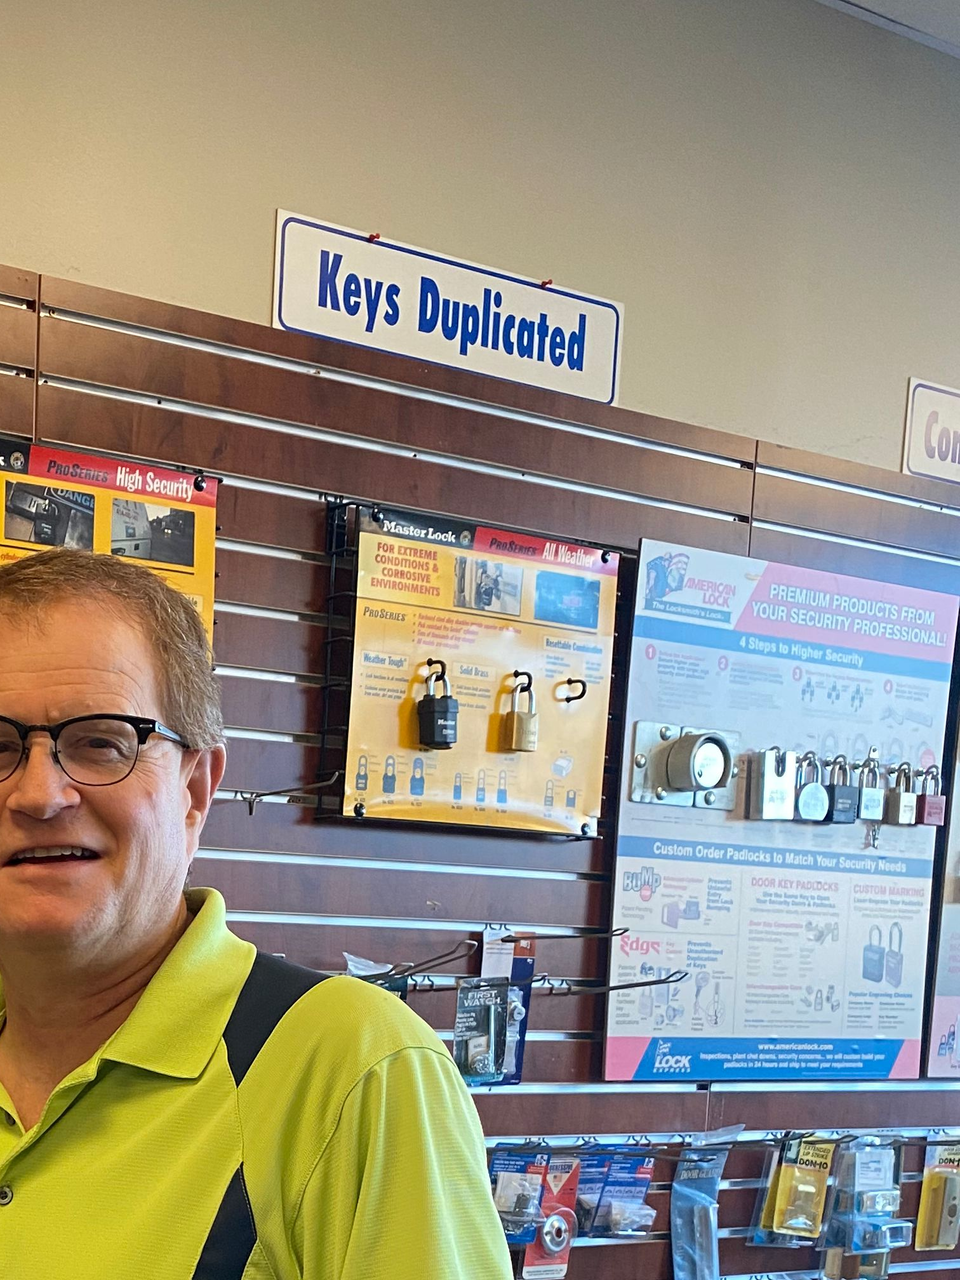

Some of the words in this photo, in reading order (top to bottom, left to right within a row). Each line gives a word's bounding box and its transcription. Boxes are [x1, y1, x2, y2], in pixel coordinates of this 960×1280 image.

[318, 250, 400, 332] Keys
[418, 276, 586, 371] Duplicated
[117, 466, 142, 492] High
[146, 472, 193, 502] Security
[383, 520, 426, 538] Master
[428, 527, 456, 543] Lock
[377, 541, 395, 554] FOR
[397, 545, 437, 560] EXTREME
[543, 542, 555, 560] All
[559, 545, 594, 567] Weather
[375, 554, 429, 572] CONDITIONS
[432, 564, 439, 572] &
[381, 566, 431, 583] CORROSIVE
[371, 577, 440, 597] ENVIRONMENTS
[685, 577, 736, 597] AMERICAN
[652, 601, 665, 611] The
[702, 591, 730, 609] LOCK
[770, 584, 830, 607] PREMIUM
[833, 595, 898, 619] PRODUCTS
[901, 607, 935, 625] FROM
[752, 601, 787, 621] YOUR
[790, 609, 851, 632] SECURITY
[854, 619, 947, 647] PROFESSIONAL!
[740, 637, 746, 648] 4
[748, 638, 777, 655] Steps
[779, 641, 789, 654] to
[792, 643, 823, 663] Higher
[826, 649, 864, 667] Security
[653, 842, 693, 857] Custom
[696, 845, 724, 859] Order
[727, 847, 771, 863] Padlocks
[773, 852, 782, 864] to
[785, 852, 813, 867] Match
[816, 855, 837, 869] Your
[839, 856, 876, 873] Security
[878, 859, 906, 872] Needs
[751, 877, 776, 887] DOOR
[778, 880, 794, 889] KEY
[796, 881, 839, 892] PADLOCKS
[468, 991, 497, 999] FIRST
[655, 1056, 691, 1068] LOCK
[804, 1145, 831, 1154] EXTENDED
[811, 1152, 828, 1160] STRIKE
